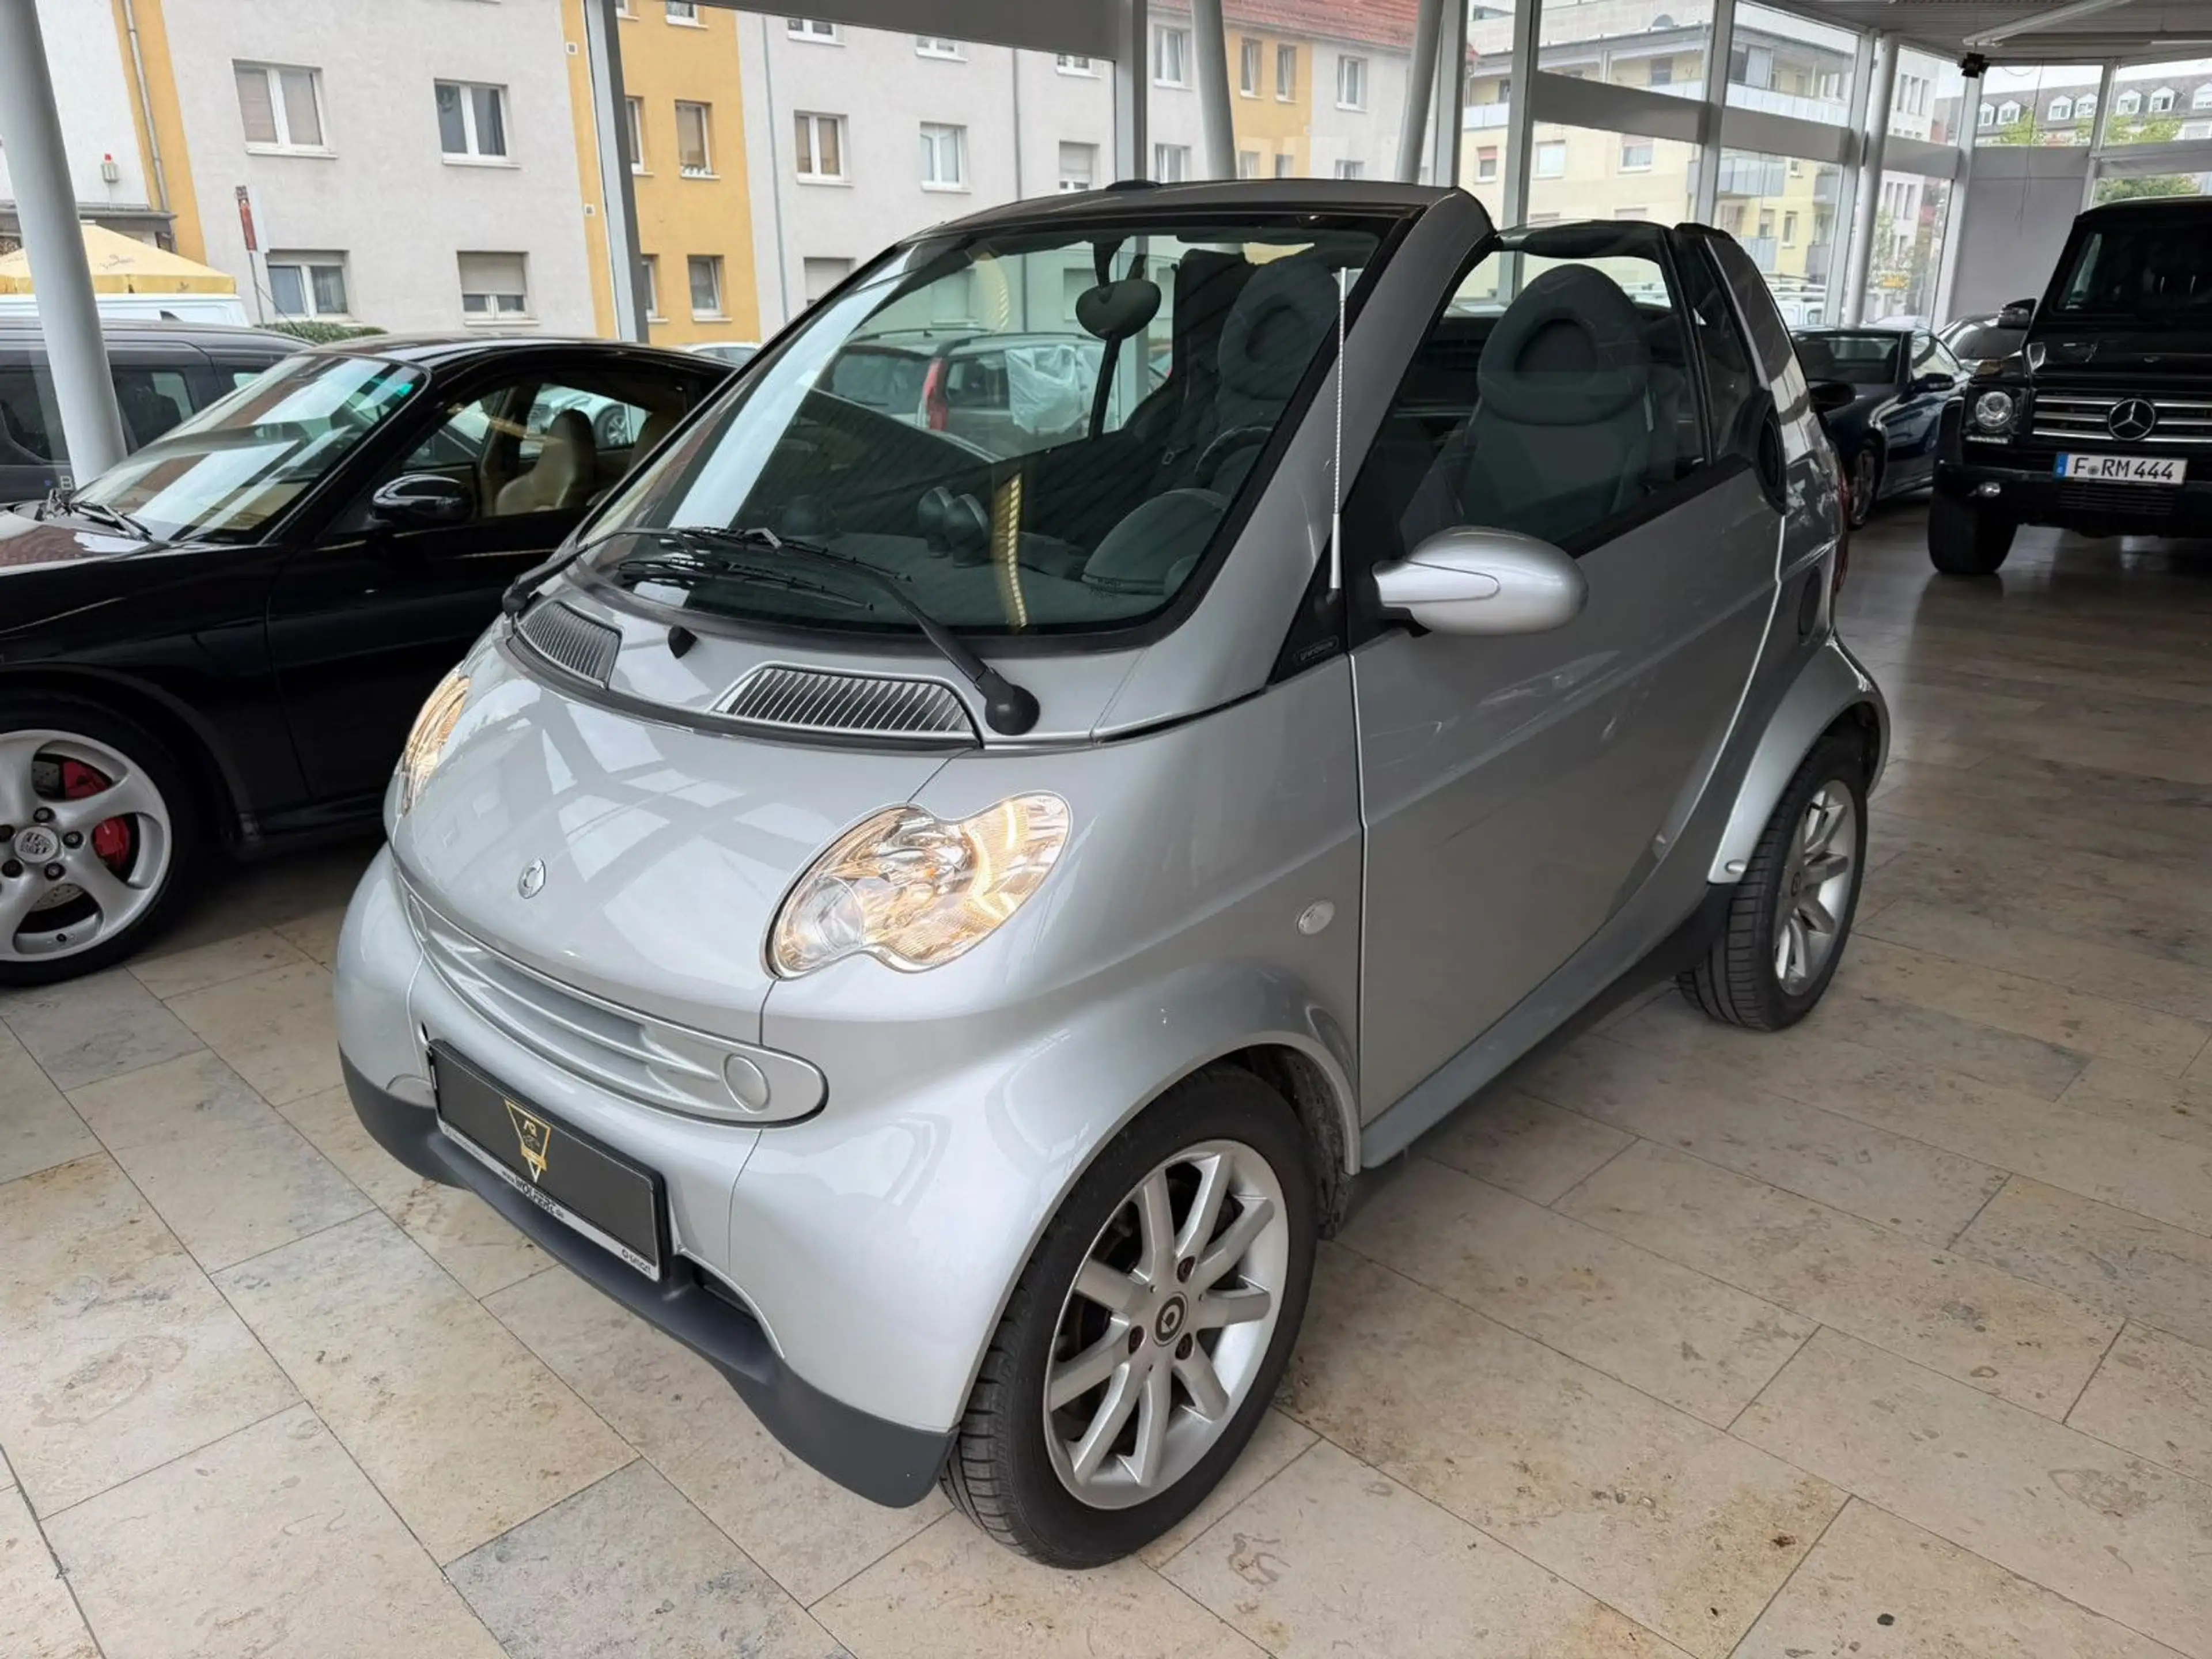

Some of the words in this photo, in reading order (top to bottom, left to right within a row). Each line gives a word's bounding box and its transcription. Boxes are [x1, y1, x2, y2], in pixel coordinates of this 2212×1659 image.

[2073, 457, 2089, 474] F
[2101, 459, 2130, 478] RM
[2134, 460, 2175, 480] 444
